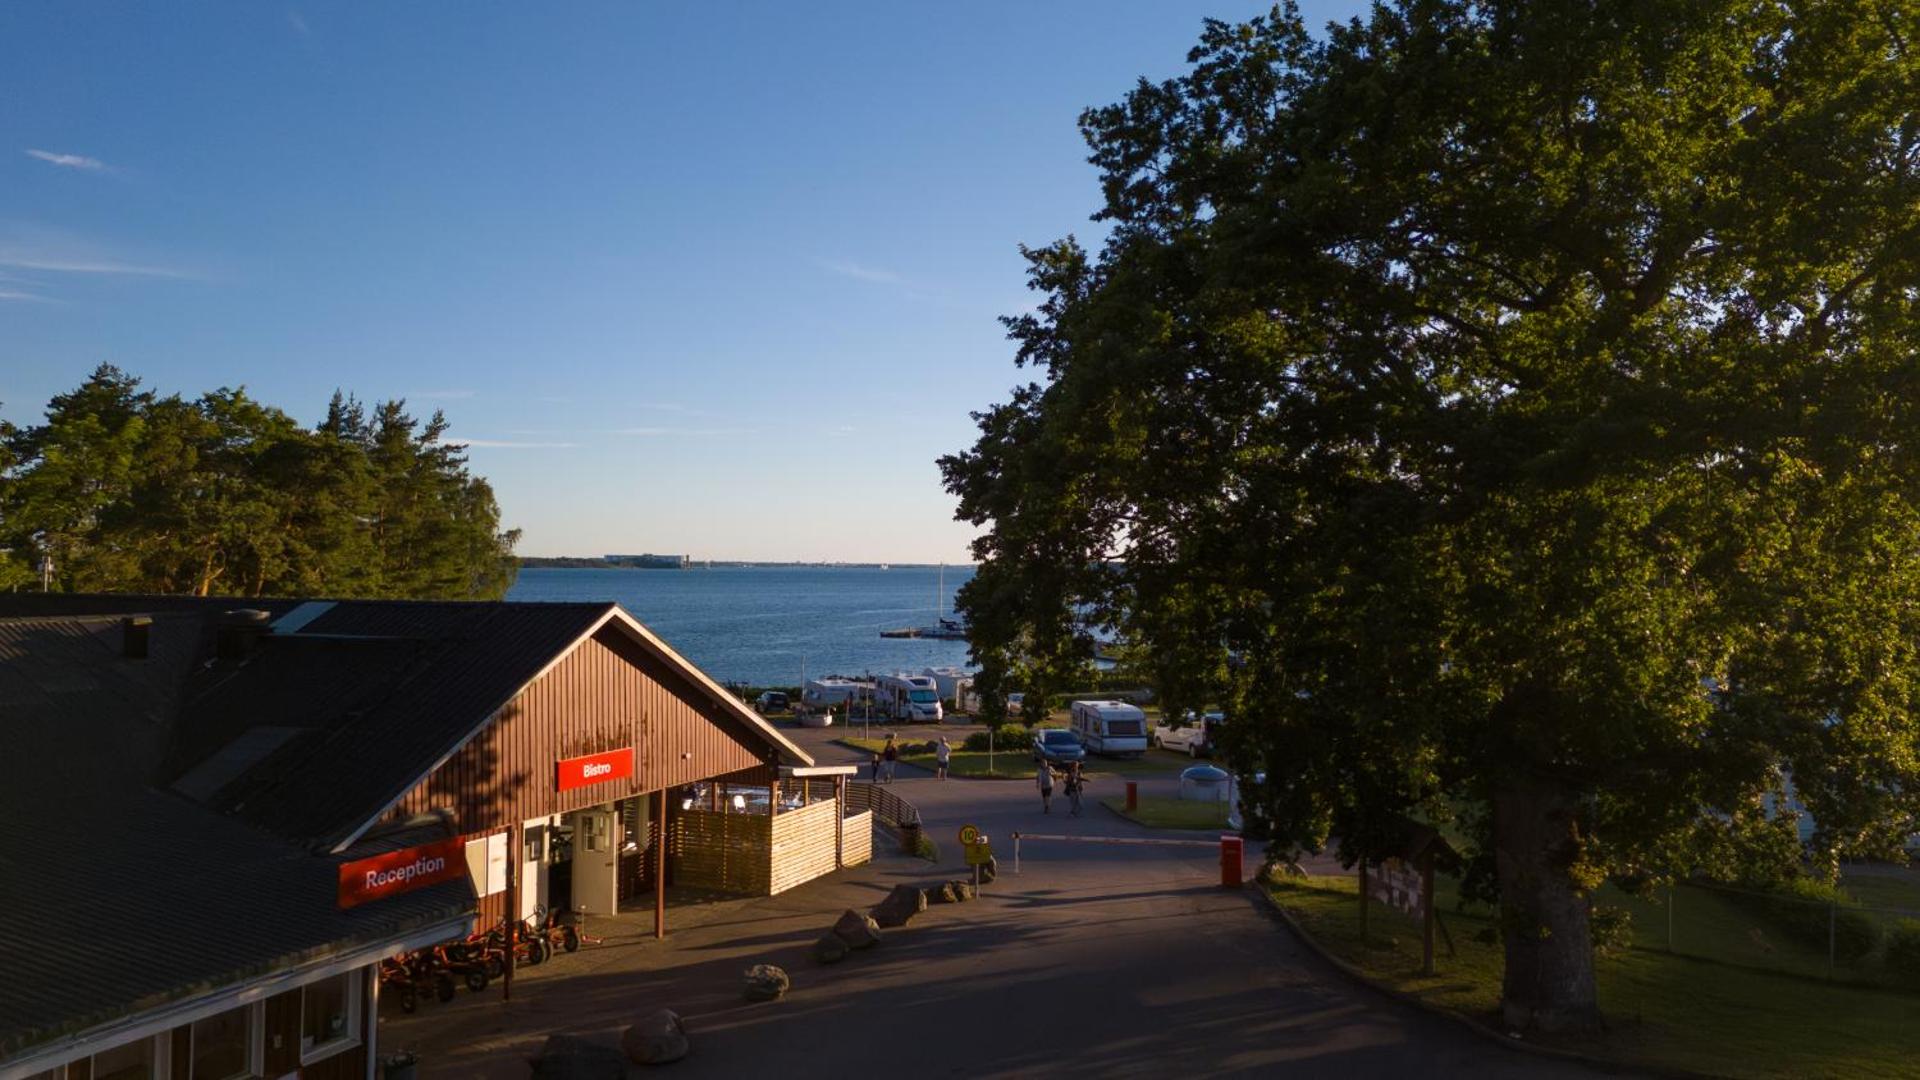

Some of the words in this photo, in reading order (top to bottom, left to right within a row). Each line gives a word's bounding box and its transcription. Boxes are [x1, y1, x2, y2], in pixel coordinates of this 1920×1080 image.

[583, 762, 611, 777] Bistro
[964, 830, 974, 840] 10
[365, 856, 445, 889] Reception
